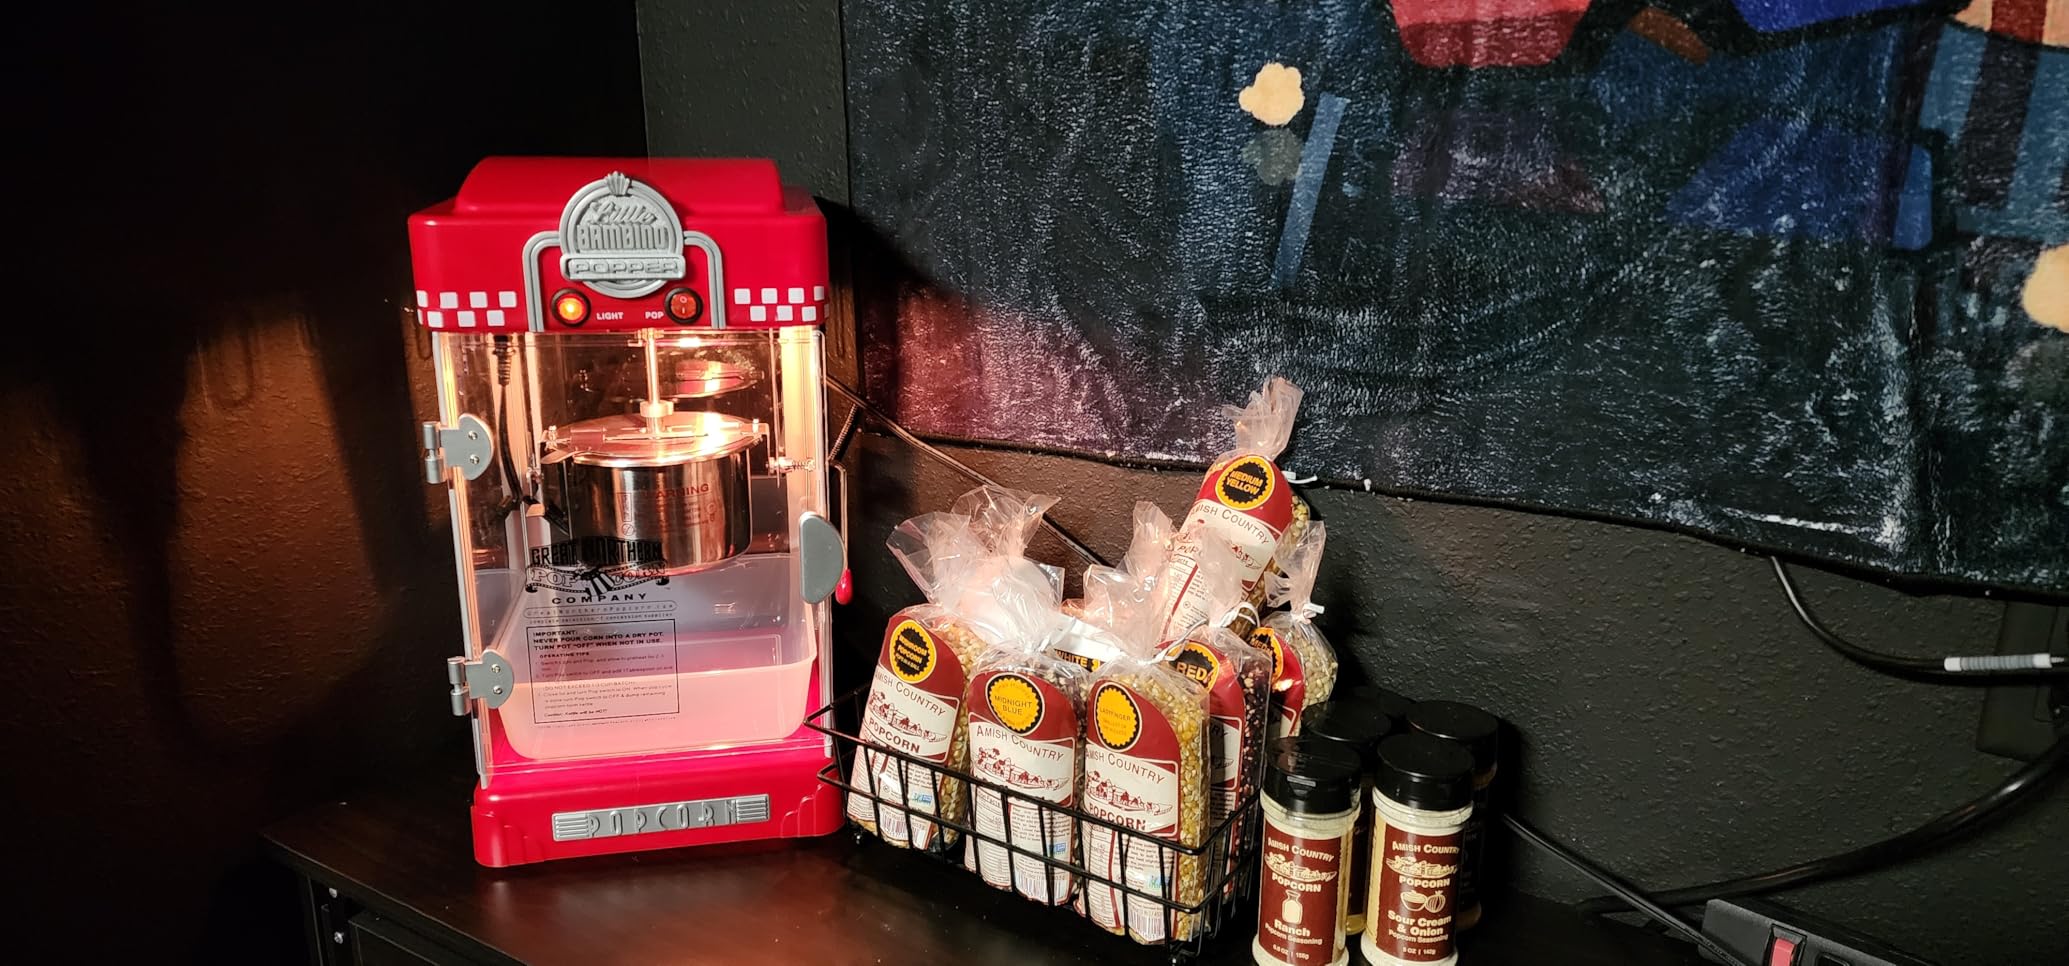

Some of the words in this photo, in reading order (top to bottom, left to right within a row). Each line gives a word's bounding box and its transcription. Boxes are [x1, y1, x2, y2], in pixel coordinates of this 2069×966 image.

[586, 200, 658, 225] Little
[577, 224, 669, 250] BAMBINO
[574, 260, 680, 275] POPPER
[596, 312, 624, 320] LIGHT
[645, 311, 664, 319] POP
[1226, 477, 1260, 495] YELLOW
[1229, 470, 1263, 487] MEDIUM
[648, 483, 709, 498] ARNING
[1221, 509, 1269, 544] COUNTRY
[531, 541, 577, 566] GREAT
[532, 568, 577, 587] POP
[552, 593, 646, 604] COMPANY
[1055, 650, 1088, 667] WHITE
[1176, 662, 1208, 681] RED
[895, 681, 946, 717] COUNTRY
[994, 695, 1033, 708] MIDNIGHT
[1002, 705, 1023, 715] BLUE
[869, 718, 920, 753] POPCORN
[976, 725, 1008, 740] AMISH
[1011, 735, 1064, 760] COUNTRY
[1108, 753, 1165, 784] COUNTRY
[587, 800, 737, 838] POPCORN
[1089, 803, 1146, 830] POPCORN
[1267, 837, 1289, 852] AMISH
[1291, 845, 1335, 862] COUNTRY
[1392, 840, 1421, 853] AMISH
[1423, 844, 1460, 854] COUNTRY
[1271, 872, 1322, 892] POPCORN
[1399, 874, 1450, 888] POPCORN
[1387, 909, 1416, 925] Sour
[1417, 915, 1452, 927] Cream
[1274, 918, 1311, 937] Ranch
[1388, 928, 1417, 942] Popcorn
[1417, 934, 1449, 943] Seasoning
[1396, 924, 1407, 934] &
[1410, 926, 1443, 937] Onion
[1287, 934, 1323, 945] Seasoning
